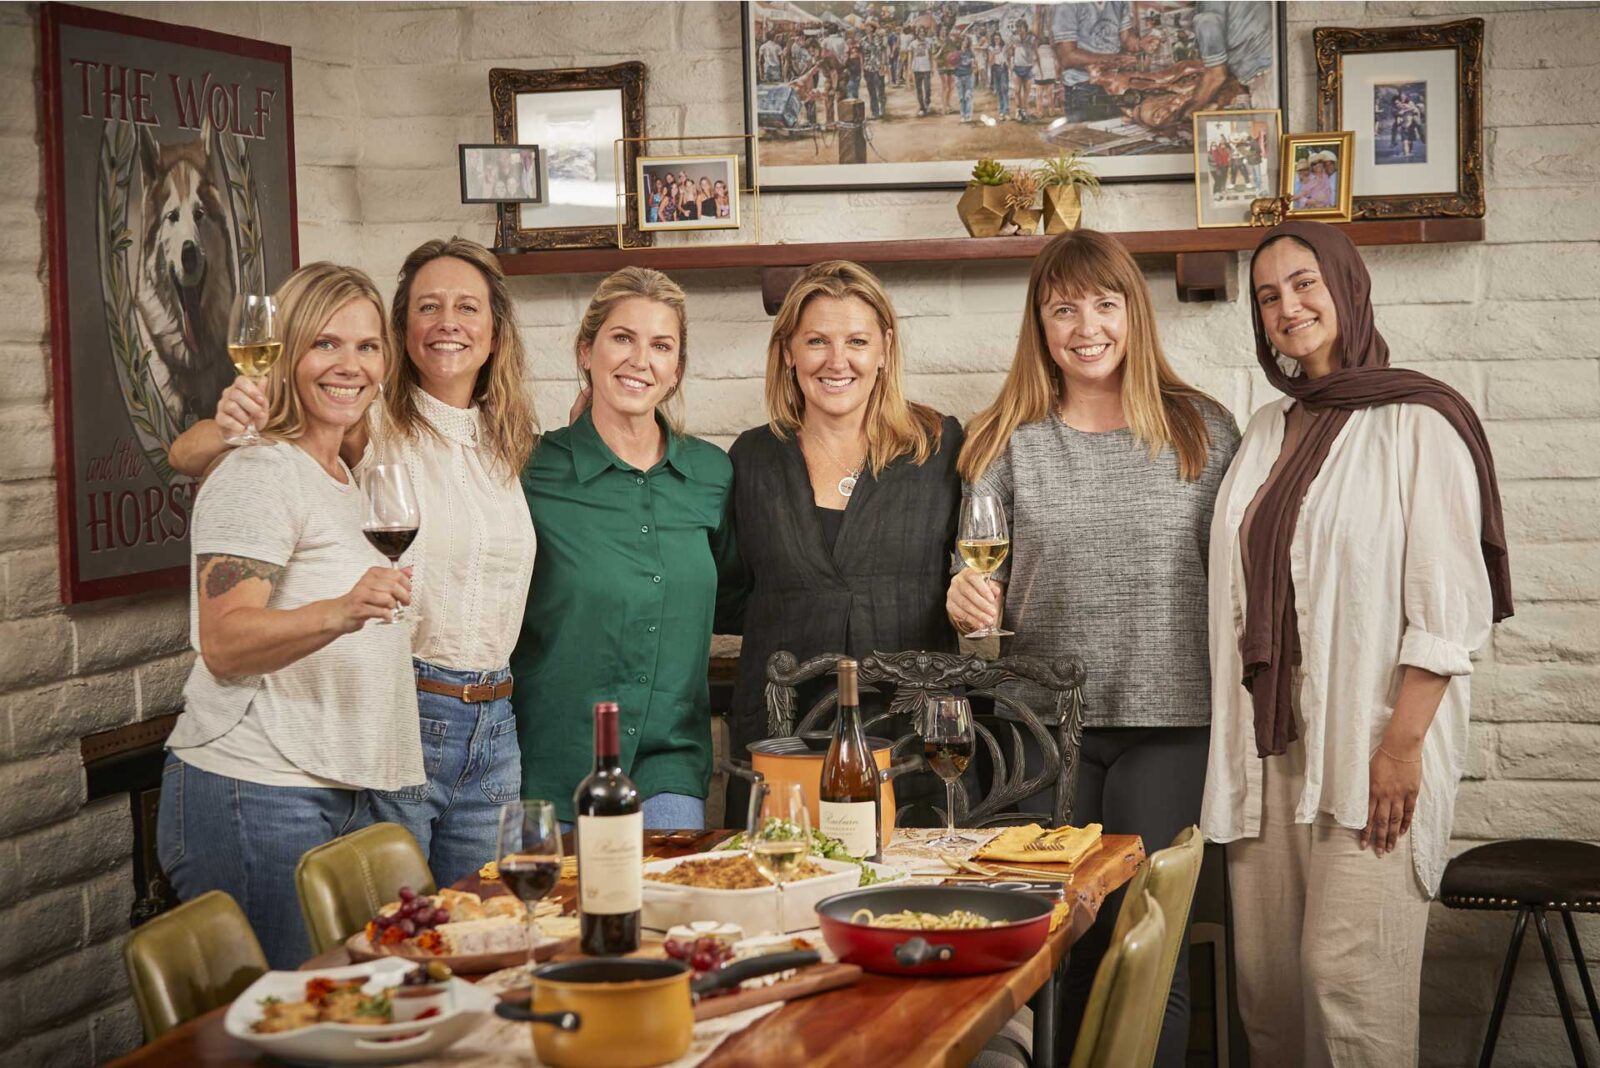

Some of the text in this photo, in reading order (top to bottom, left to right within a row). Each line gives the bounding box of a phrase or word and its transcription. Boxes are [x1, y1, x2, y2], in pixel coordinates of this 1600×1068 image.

[69, 58, 276, 140] THE WOLF
[86, 437, 145, 483] and the
